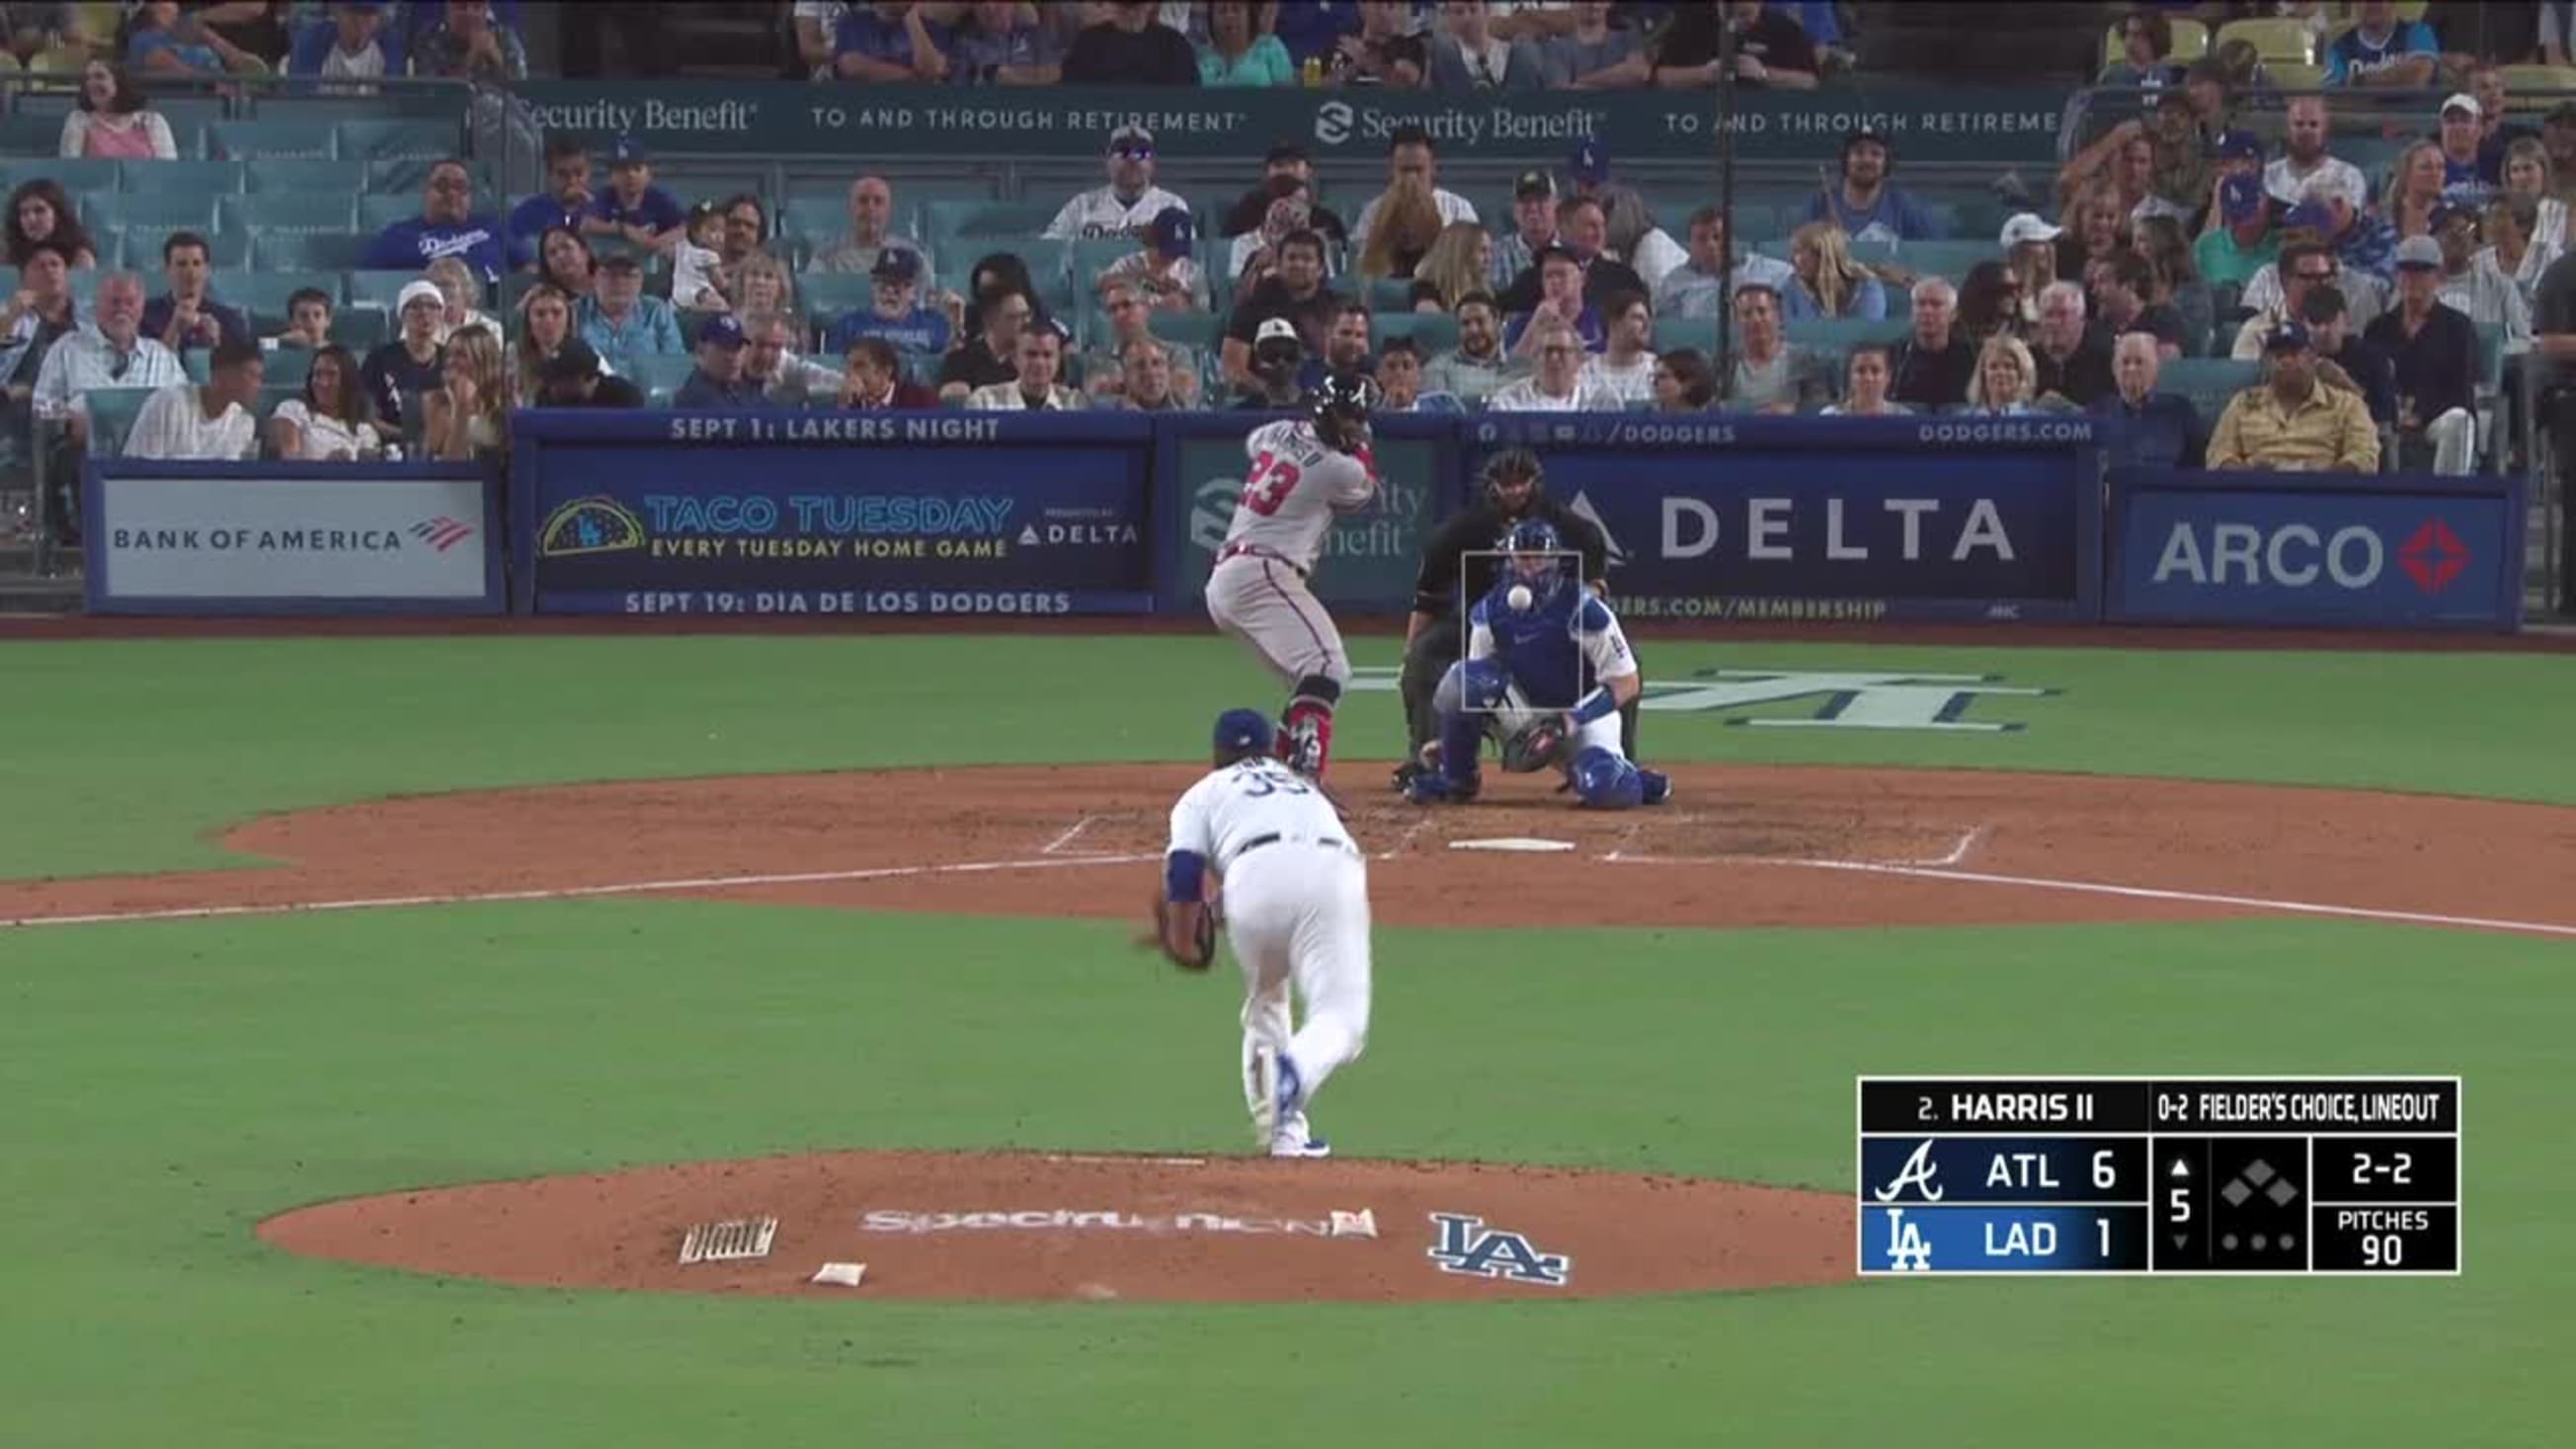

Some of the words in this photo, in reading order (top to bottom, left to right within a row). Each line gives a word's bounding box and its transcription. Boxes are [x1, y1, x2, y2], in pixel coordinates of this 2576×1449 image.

[530, 99, 636, 135] ecurity
[645, 100, 749, 129] Benefit
[812, 108, 846, 127] TO
[860, 109, 913, 128] AND
[927, 110, 1054, 129] THROUGH
[1068, 111, 1236, 130] RETIREMENT
[1492, 108, 1594, 137] Benefit
[1664, 113, 1698, 133] TO
[1778, 113, 1907, 132] THROUGH
[672, 417, 737, 439] SEPT
[750, 417, 774, 439] 1:
[787, 417, 895, 439] LAKERS
[906, 417, 1001, 439] NIGHT
[1918, 423, 2093, 442] DODGERS.COM
[644, 494, 778, 533] TACO
[789, 495, 1013, 534] TUESDAY
[1048, 524, 1139, 544] DELTA
[1324, 520, 1403, 555] nefit
[1661, 497, 2016, 560] DELTA
[114, 529, 201, 549] BANK
[209, 529, 250, 550] OF
[258, 529, 402, 551] AMERICA
[651, 538, 725, 558] EVERY
[739, 538, 842, 558] TUESDAY
[853, 539, 926, 558] HOME
[936, 539, 1007, 558] GAME
[2152, 523, 2384, 589] ARCO
[625, 592, 691, 613] SEPT
[703, 592, 744, 613] 19:
[756, 593, 809, 613] DIA
[820, 593, 854, 613] DE
[865, 593, 919, 613] LOS
[930, 593, 1071, 613] DODGERS
[1610, 596, 1888, 619] ERS.COM/MEMBERSHIP
